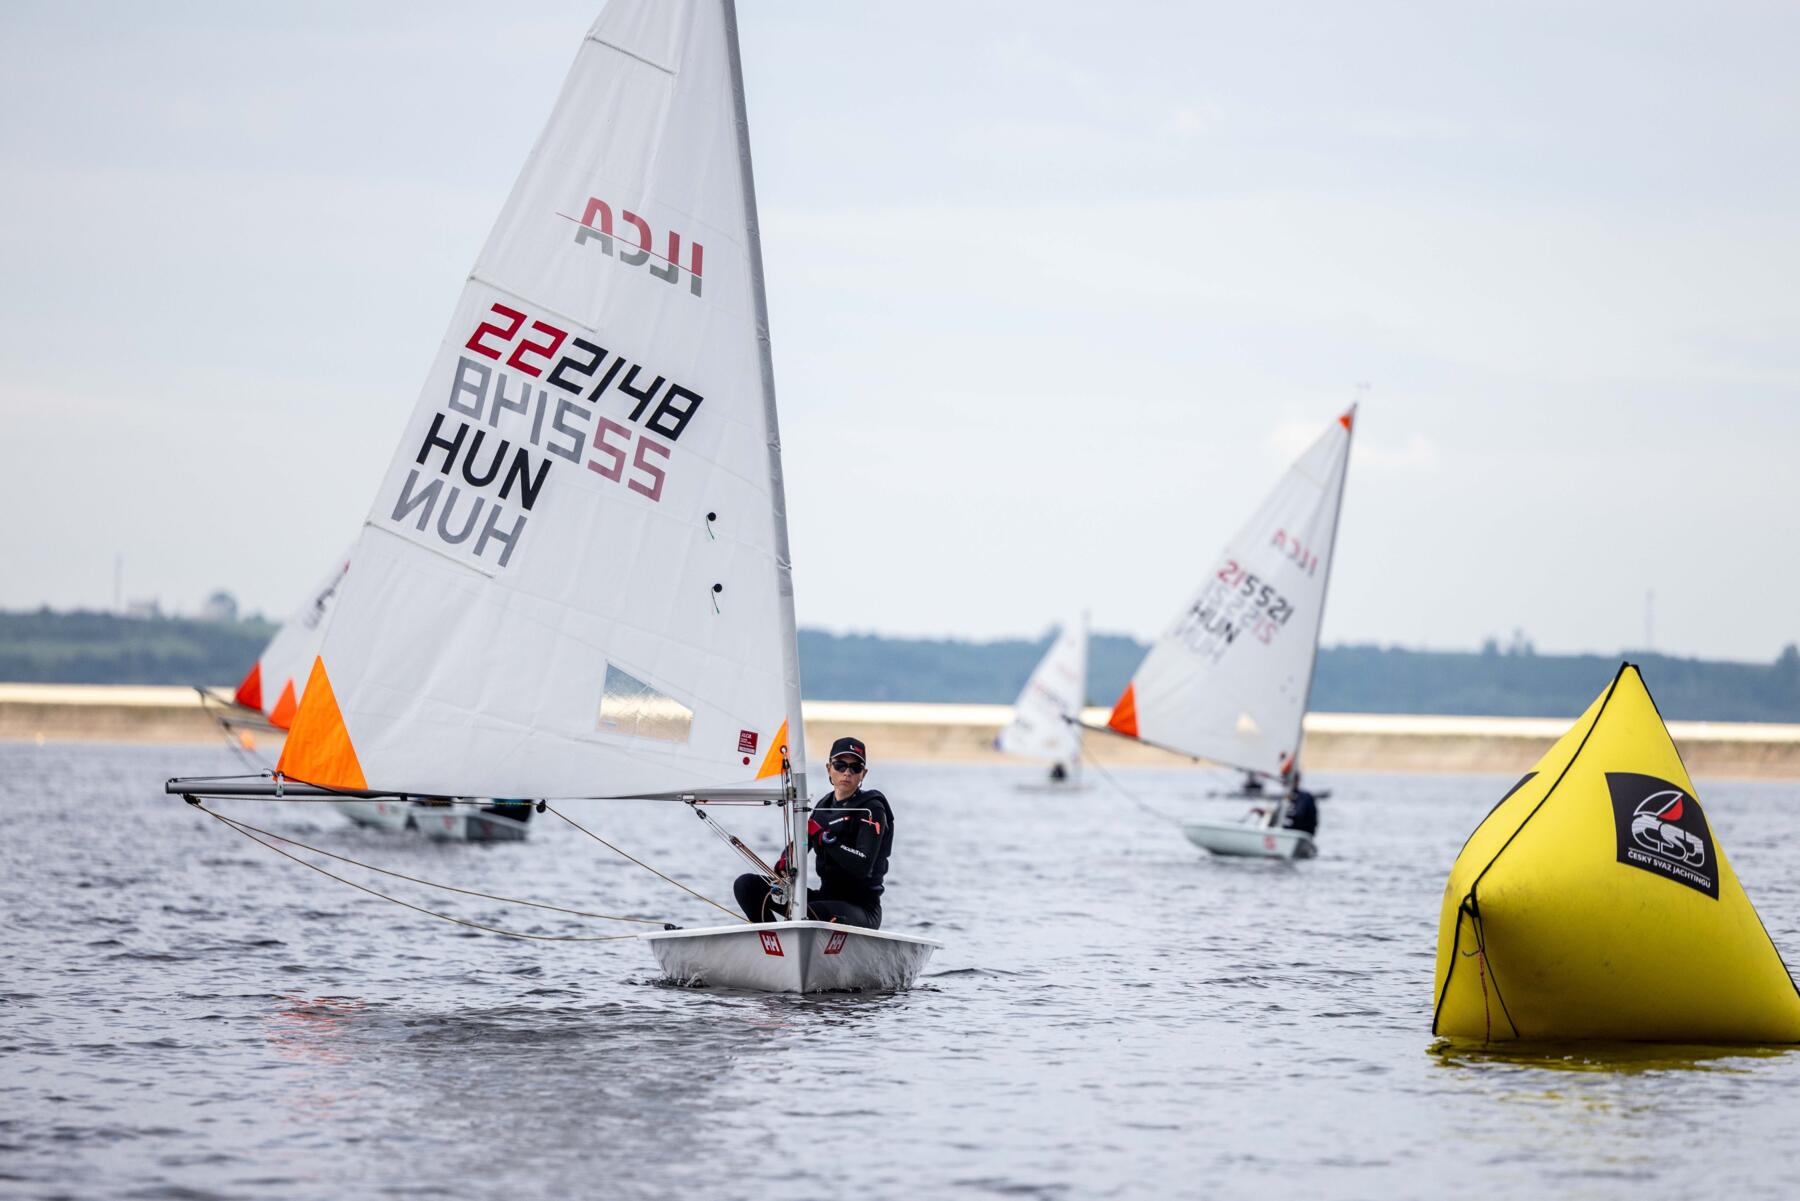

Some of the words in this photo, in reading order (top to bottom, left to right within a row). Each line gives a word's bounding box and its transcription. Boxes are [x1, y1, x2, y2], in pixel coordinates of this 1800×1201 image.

[464, 302, 704, 442] 222148
[415, 412, 552, 511] HUN
[1216, 559, 1295, 626] 215521
[1653, 858, 1672, 872] SVAZ
[1672, 866, 1711, 888] JACHTINGU
